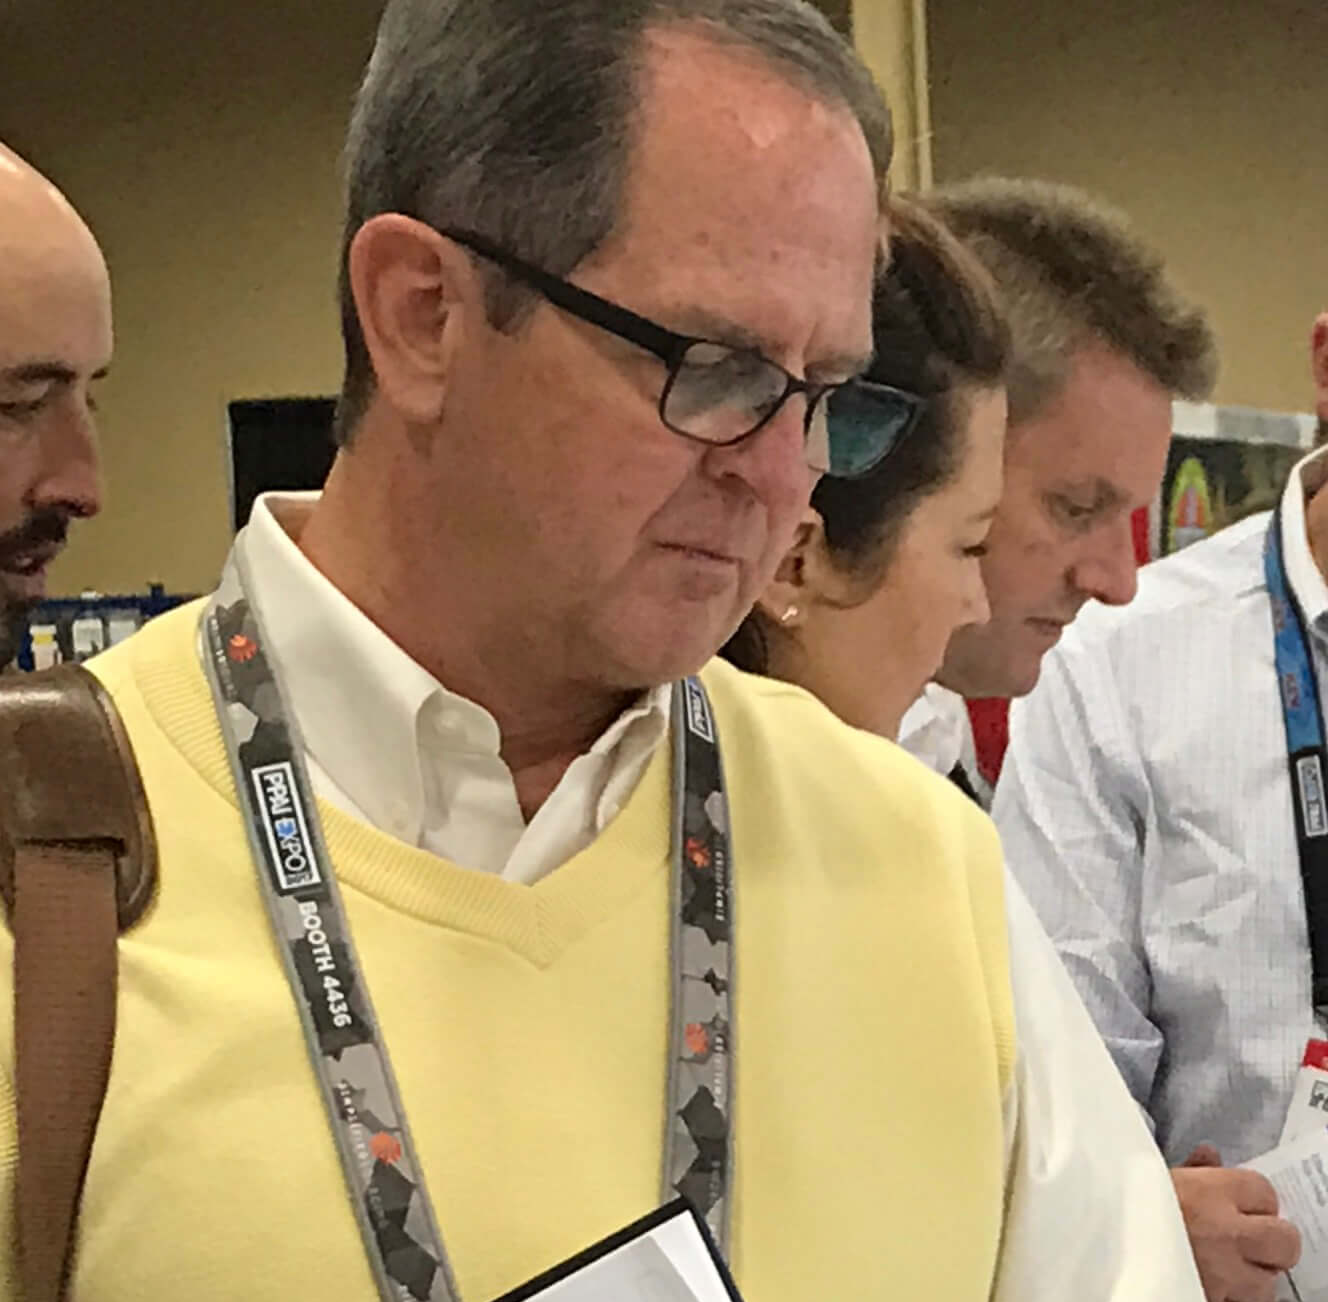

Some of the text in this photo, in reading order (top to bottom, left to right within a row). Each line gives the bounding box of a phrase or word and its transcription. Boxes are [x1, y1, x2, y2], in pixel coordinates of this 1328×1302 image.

[261, 771, 307, 874] PPAI EXPO
[298, 900, 352, 1028] BOOTH 4436
